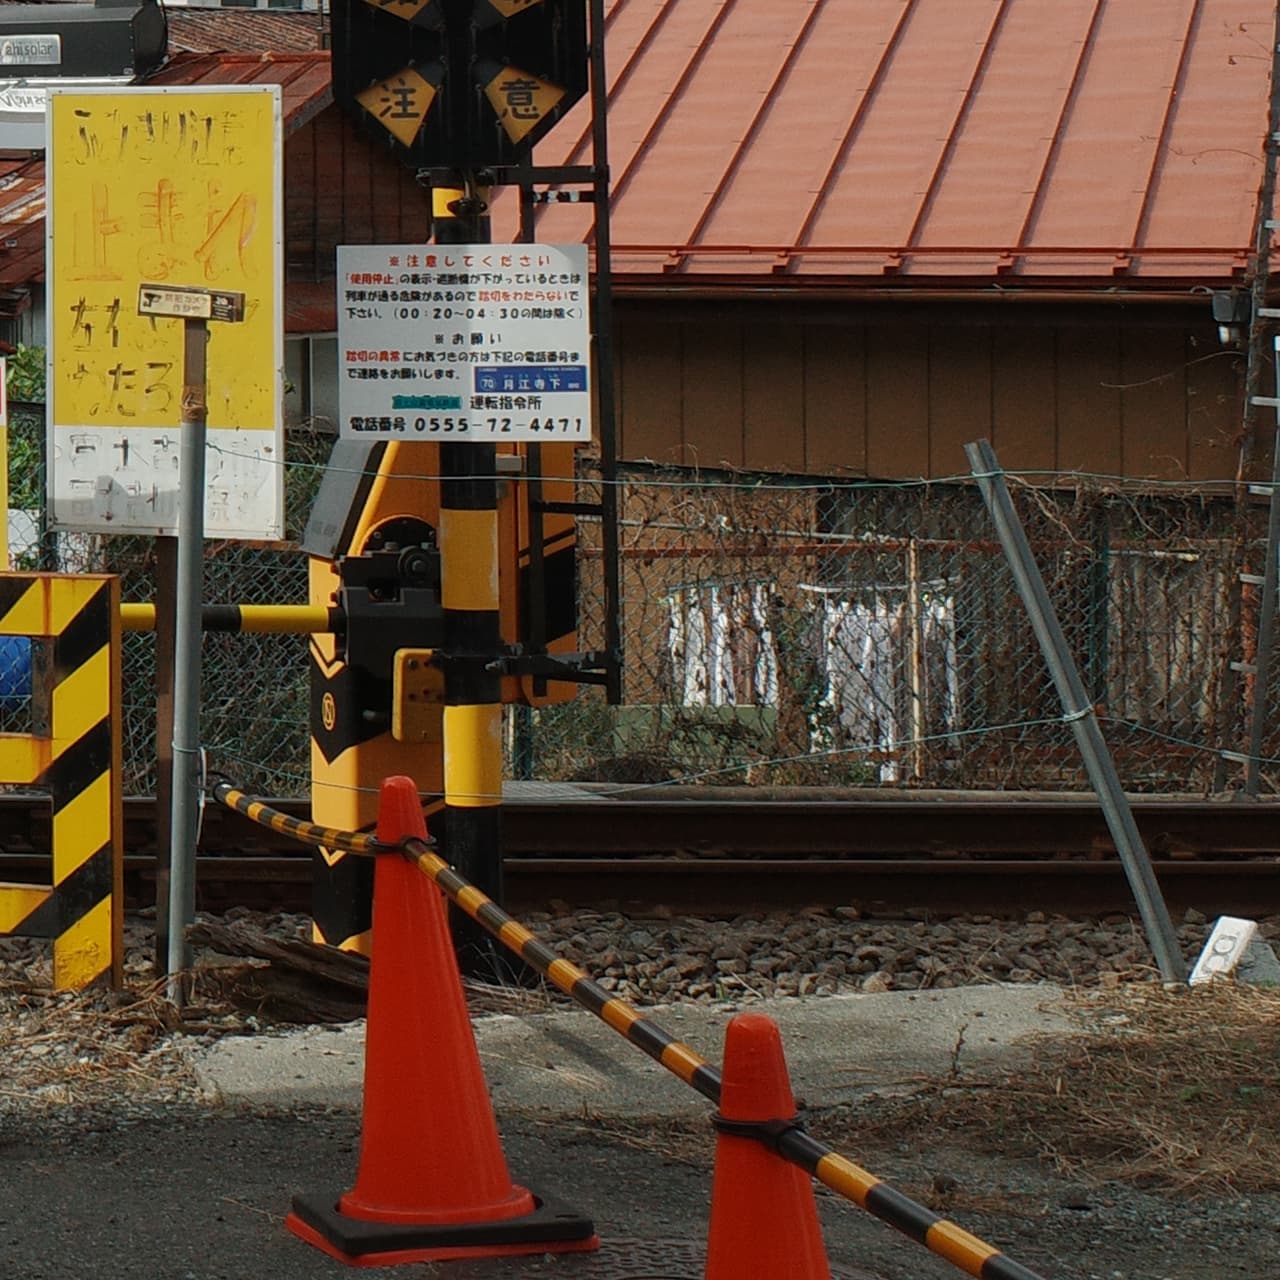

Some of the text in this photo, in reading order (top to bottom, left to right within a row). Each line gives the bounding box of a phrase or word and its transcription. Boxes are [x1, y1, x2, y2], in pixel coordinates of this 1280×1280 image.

[378, 77, 541, 120] 注意
[470, 395, 543, 410] 運転指令所
[350, 417, 406, 432] 電話番号
